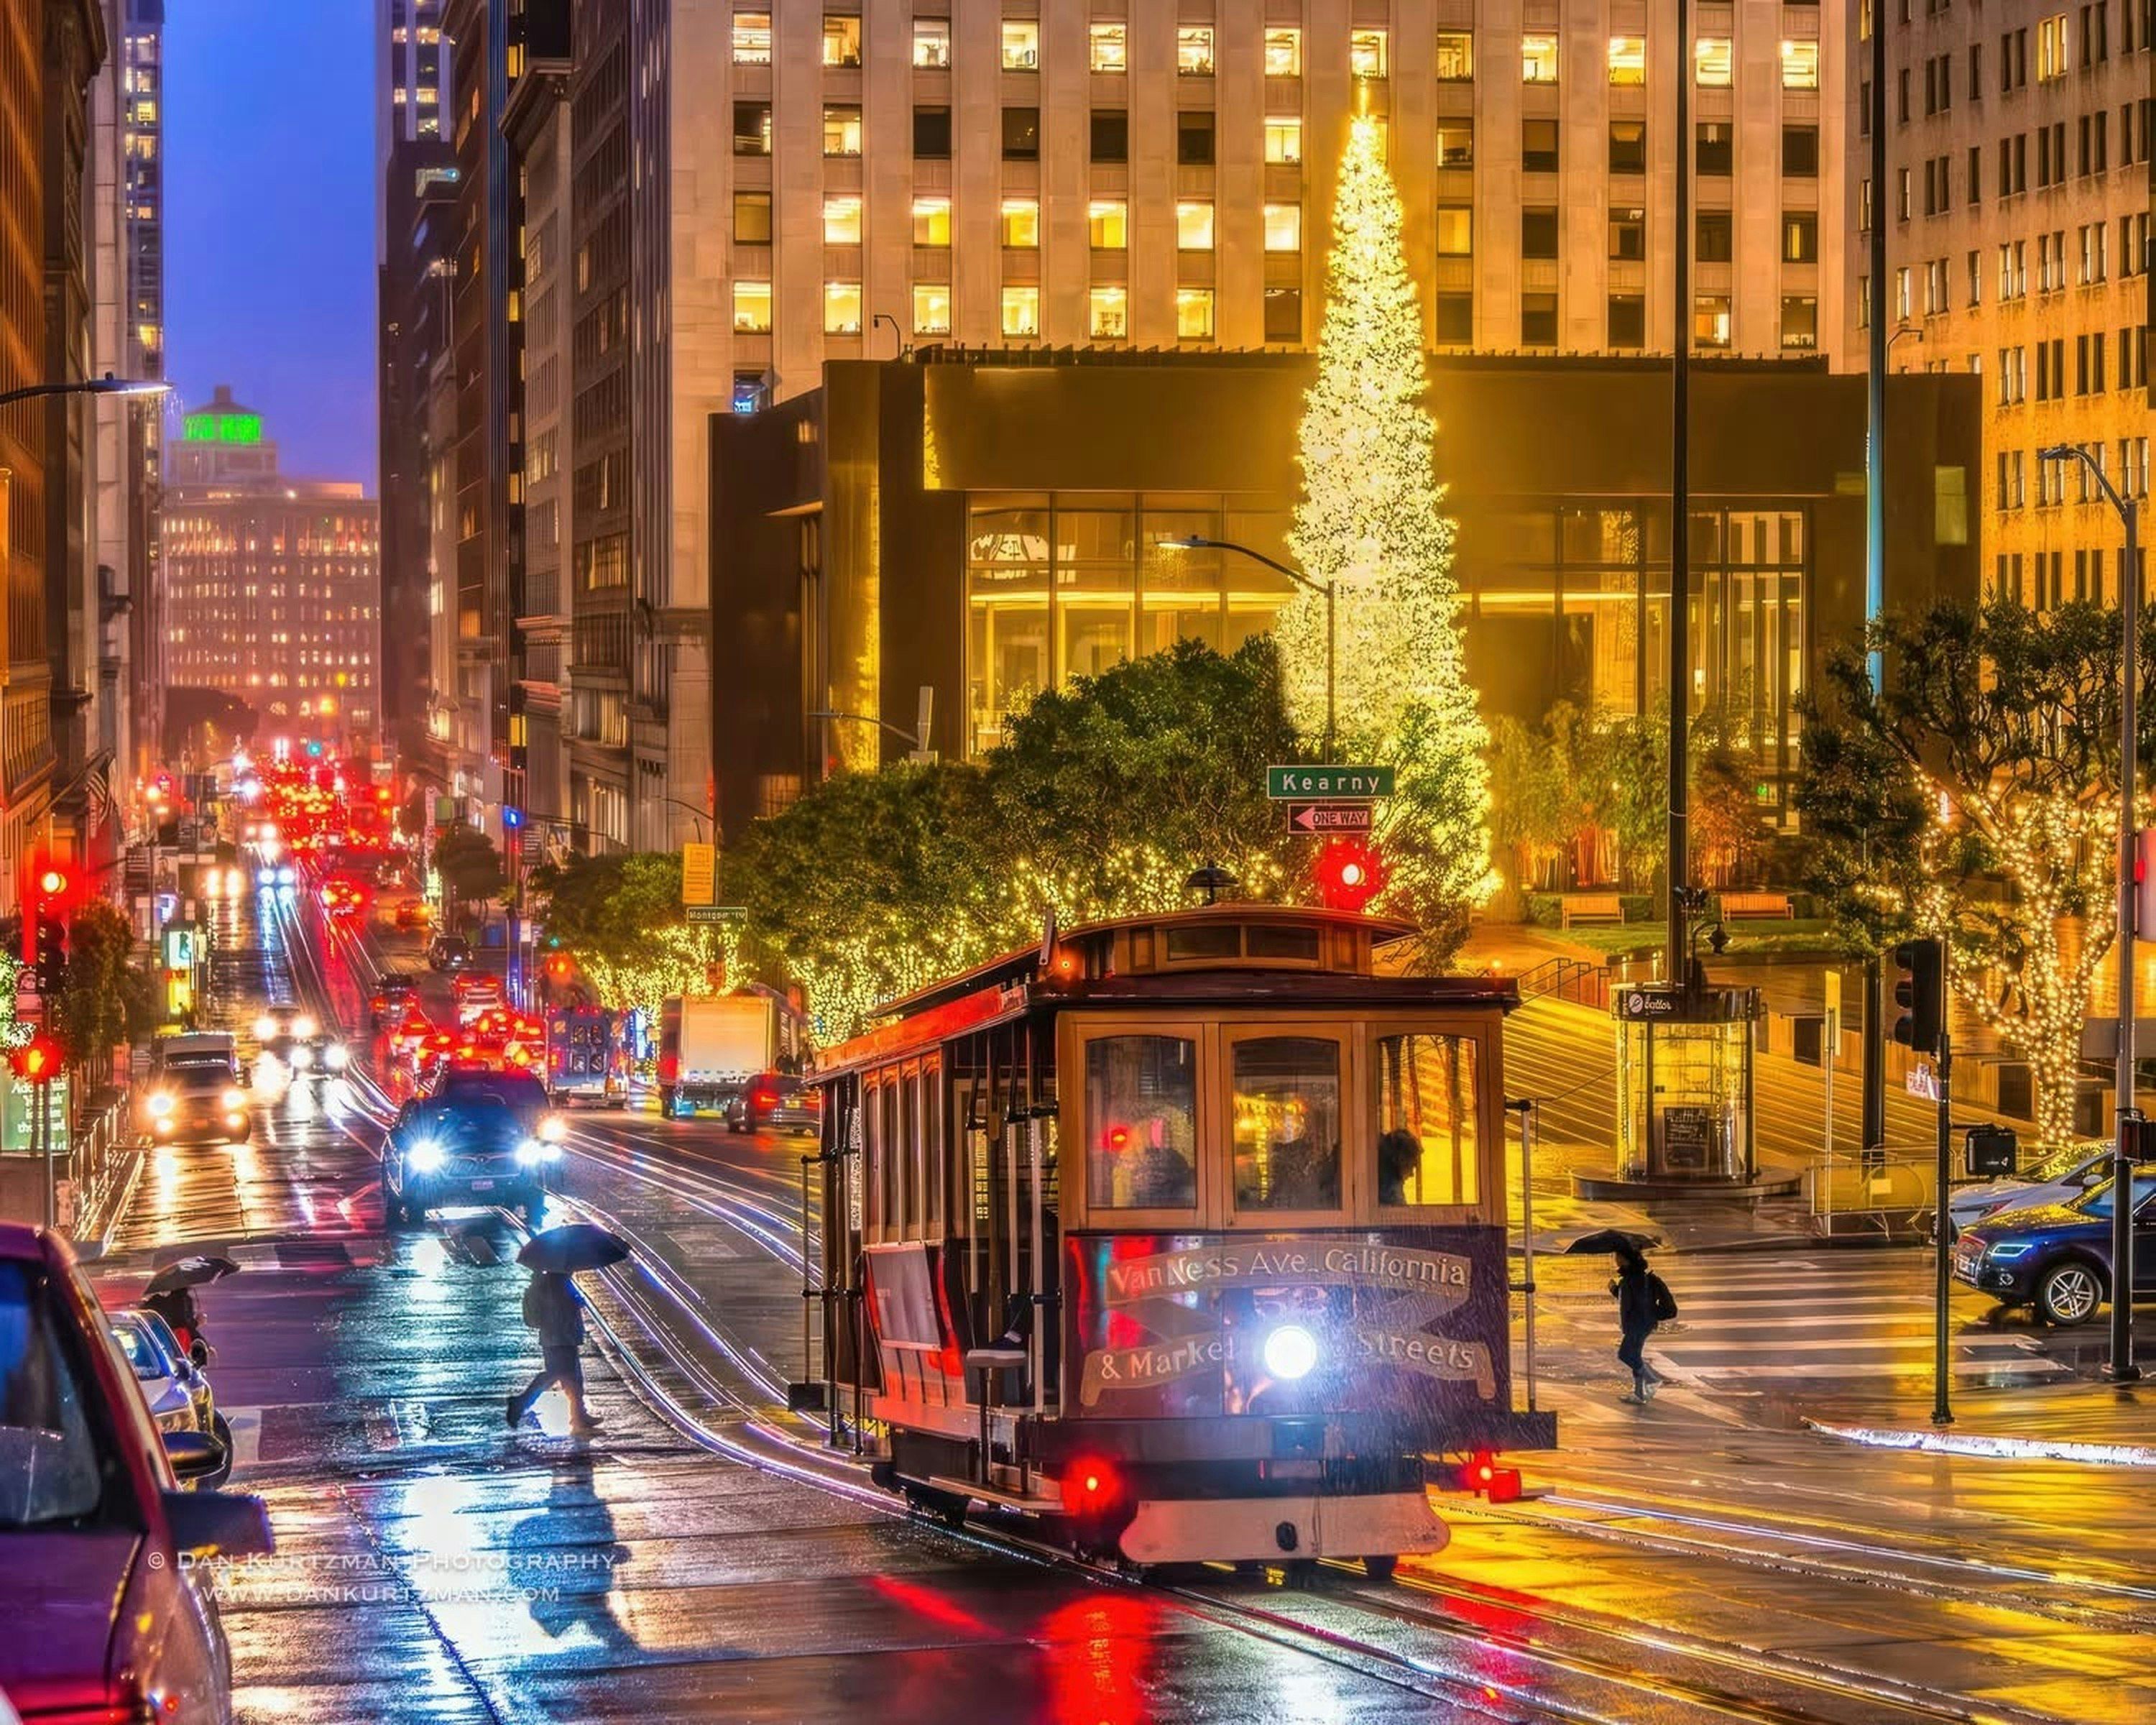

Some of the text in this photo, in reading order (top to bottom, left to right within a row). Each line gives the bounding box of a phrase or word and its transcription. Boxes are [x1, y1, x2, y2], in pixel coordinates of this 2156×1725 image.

[1283, 774, 1379, 794] Kearny
[1312, 811, 1366, 825] ONE WAY
[1110, 1266, 1163, 1294] Van
[1166, 1256, 1239, 1286] Ness
[1325, 1249, 1466, 1287] California
[1101, 1333, 1474, 1380] & Market Streets
